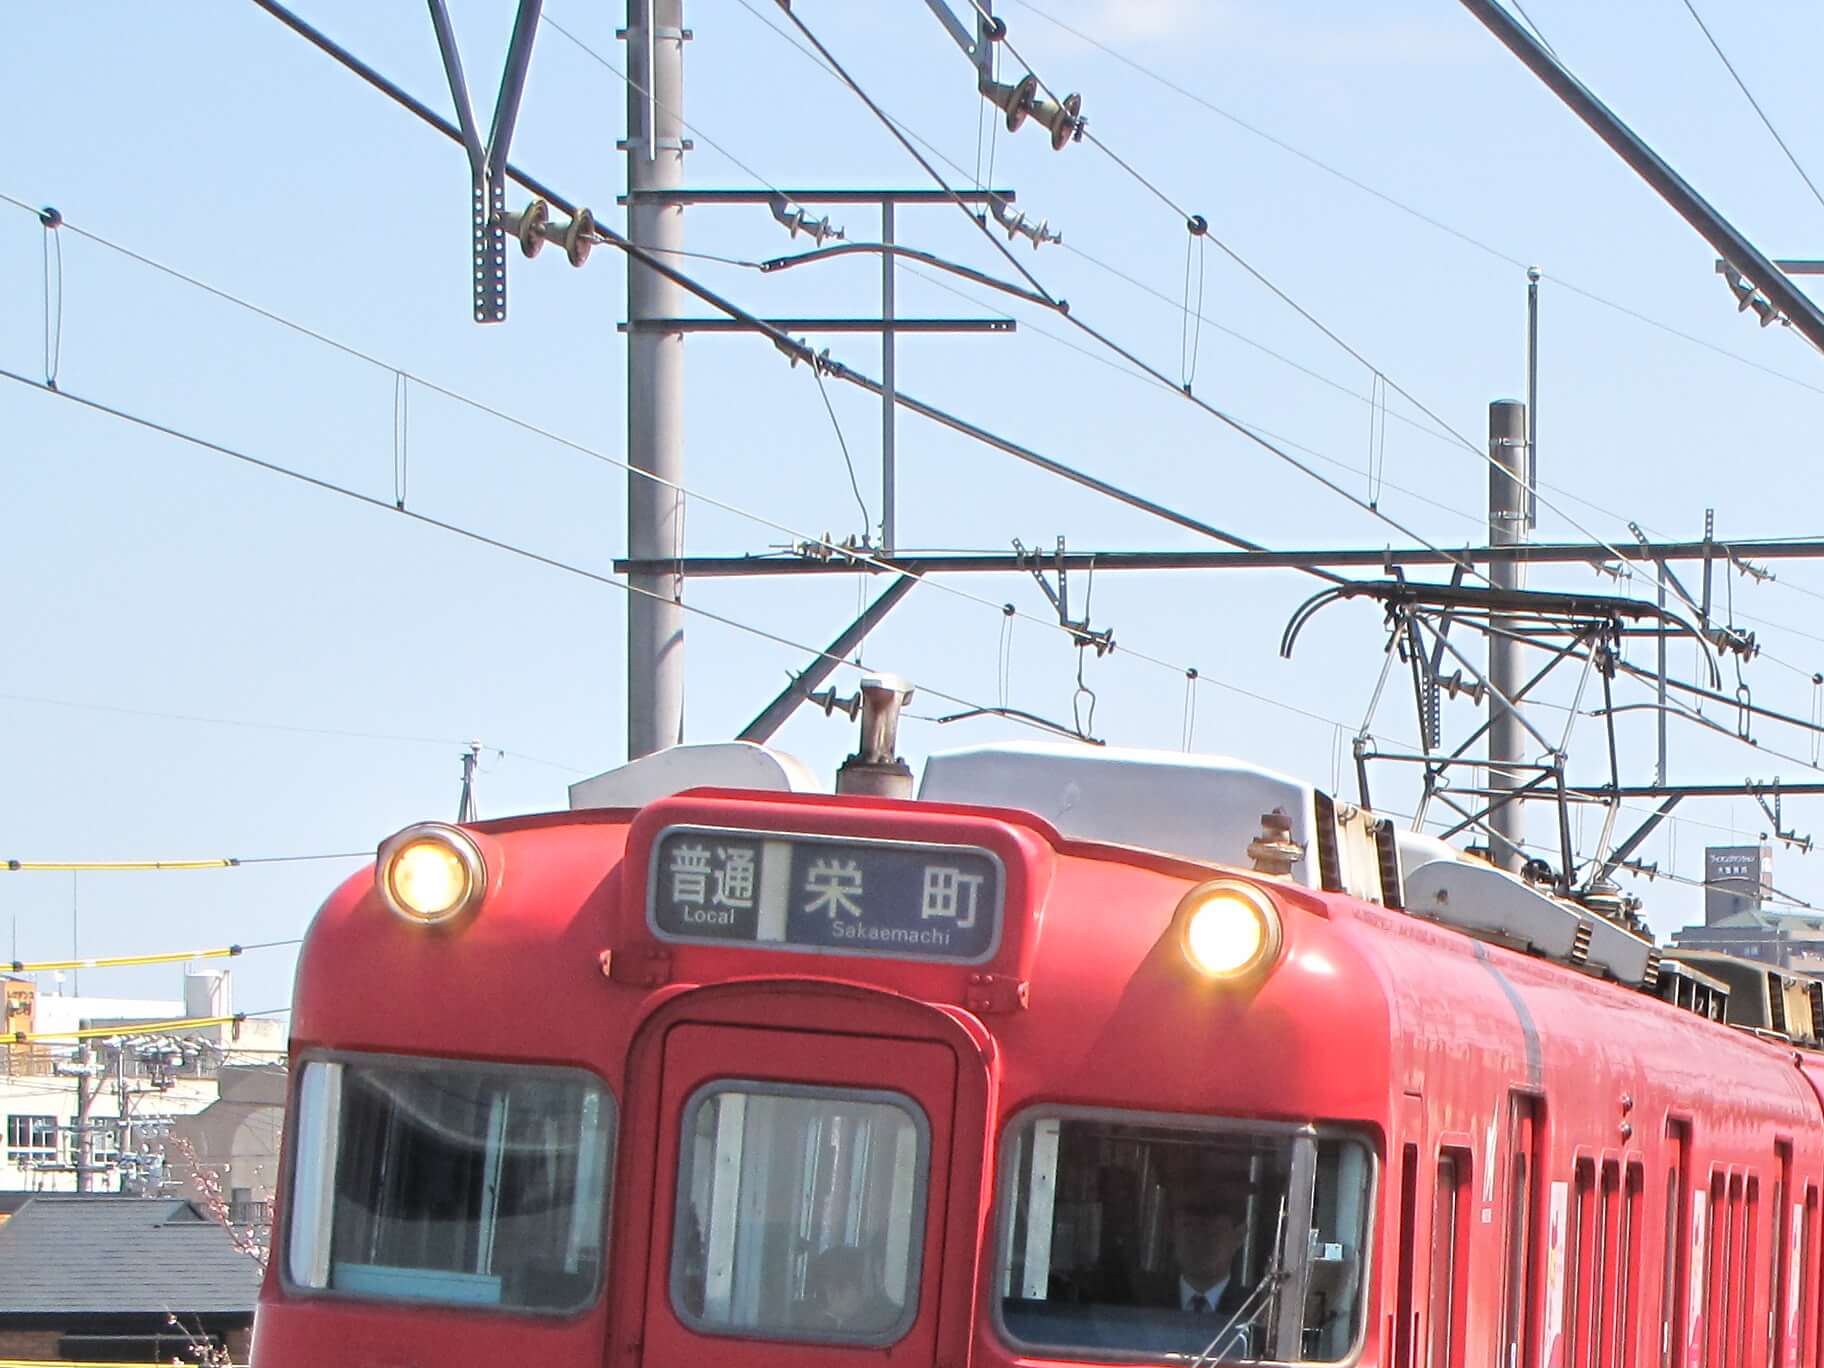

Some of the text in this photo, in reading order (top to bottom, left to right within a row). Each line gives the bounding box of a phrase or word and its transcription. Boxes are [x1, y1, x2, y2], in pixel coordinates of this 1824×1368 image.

[669, 844, 756, 909] 普通
[803, 857, 985, 929] 栄町
[683, 907, 735, 926] Local
[832, 920, 951, 946] Sakaemachi
